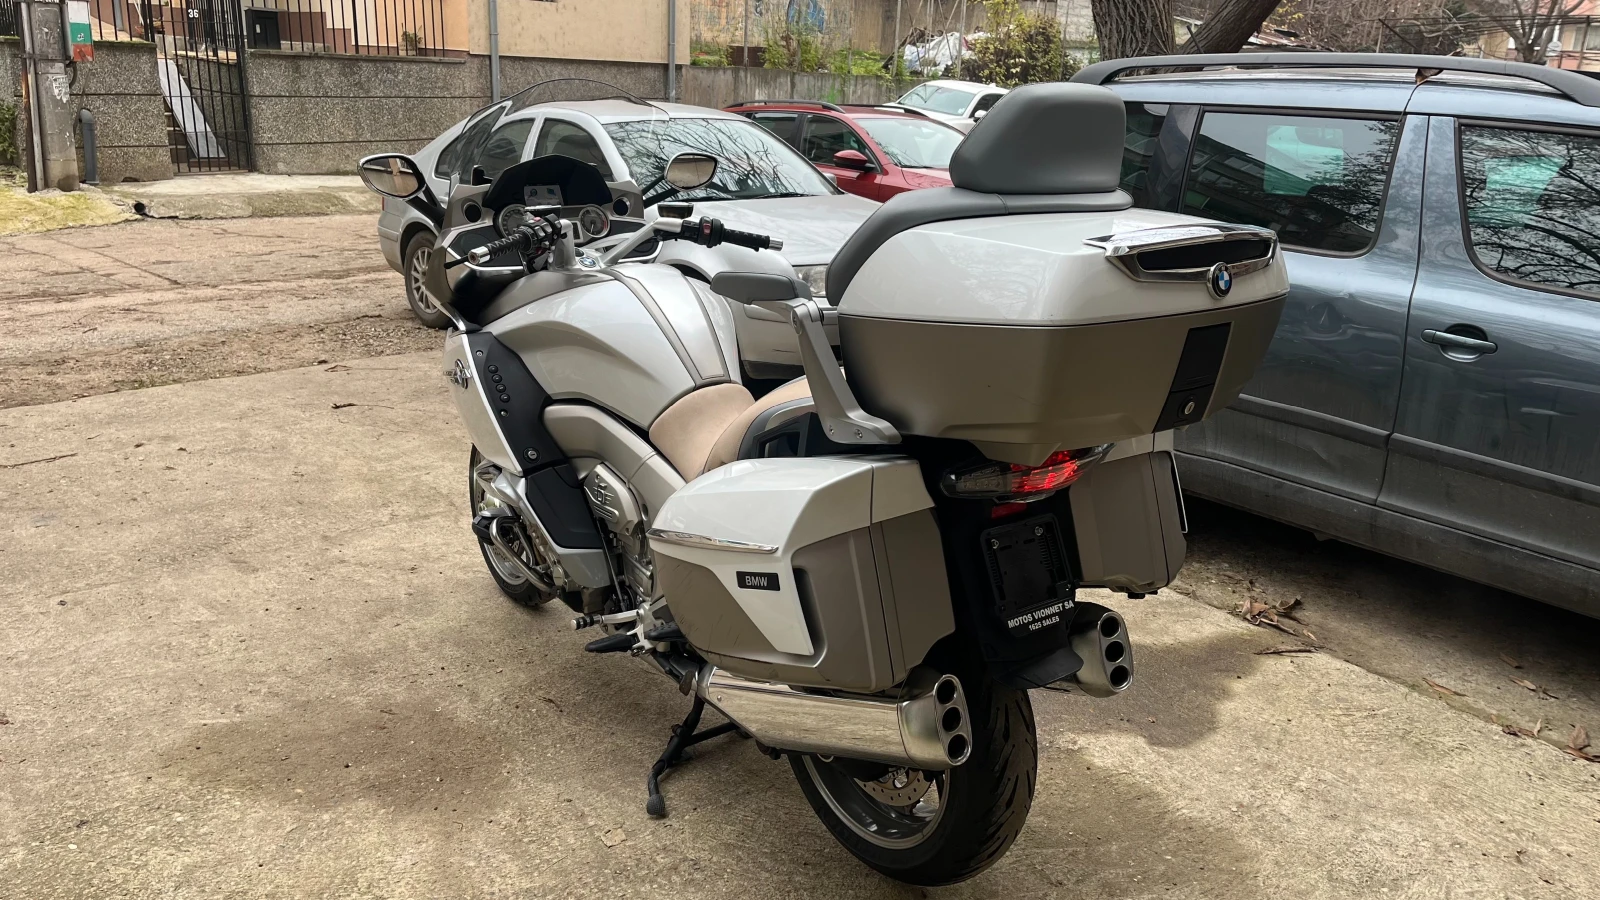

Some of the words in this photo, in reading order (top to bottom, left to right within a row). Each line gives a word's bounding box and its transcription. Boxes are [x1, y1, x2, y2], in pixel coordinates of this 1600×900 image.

[188, 9, 199, 18] 36
[745, 575, 768, 587] BMW
[1008, 614, 1033, 629] MOTOS
[1033, 603, 1063, 620] VIONNET
[1064, 599, 1075, 610] SA
[1028, 621, 1042, 631] 1625
[1042, 615, 1060, 627] SALES
